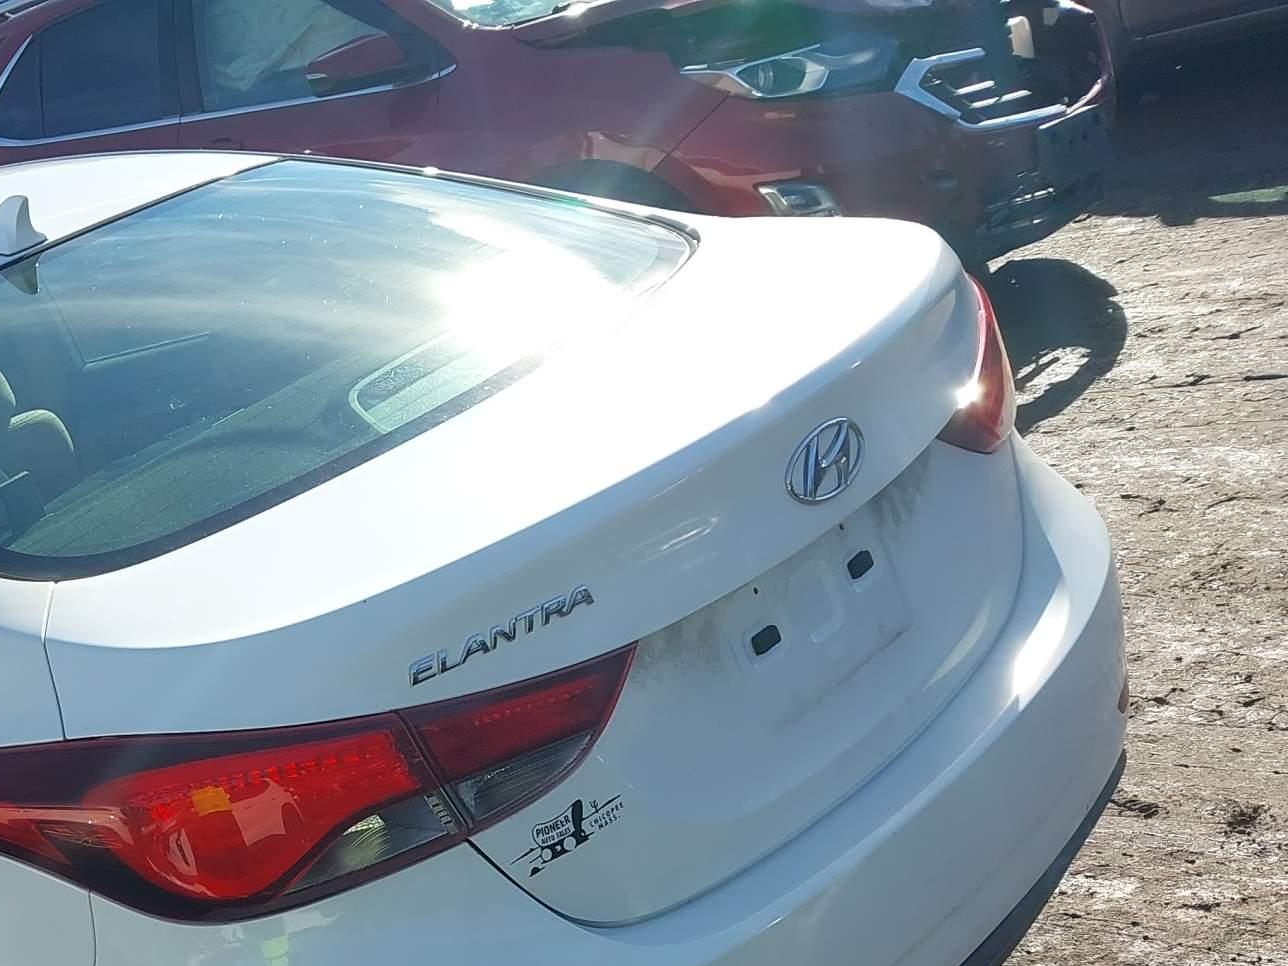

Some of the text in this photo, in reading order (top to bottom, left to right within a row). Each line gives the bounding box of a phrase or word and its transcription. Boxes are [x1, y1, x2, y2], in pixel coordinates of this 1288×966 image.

[408, 584, 594, 687] ELANTRA
[535, 815, 571, 839] PIONEER
[589, 801, 625, 828] CHICOPEE
[541, 827, 571, 845] AUTO SALES
